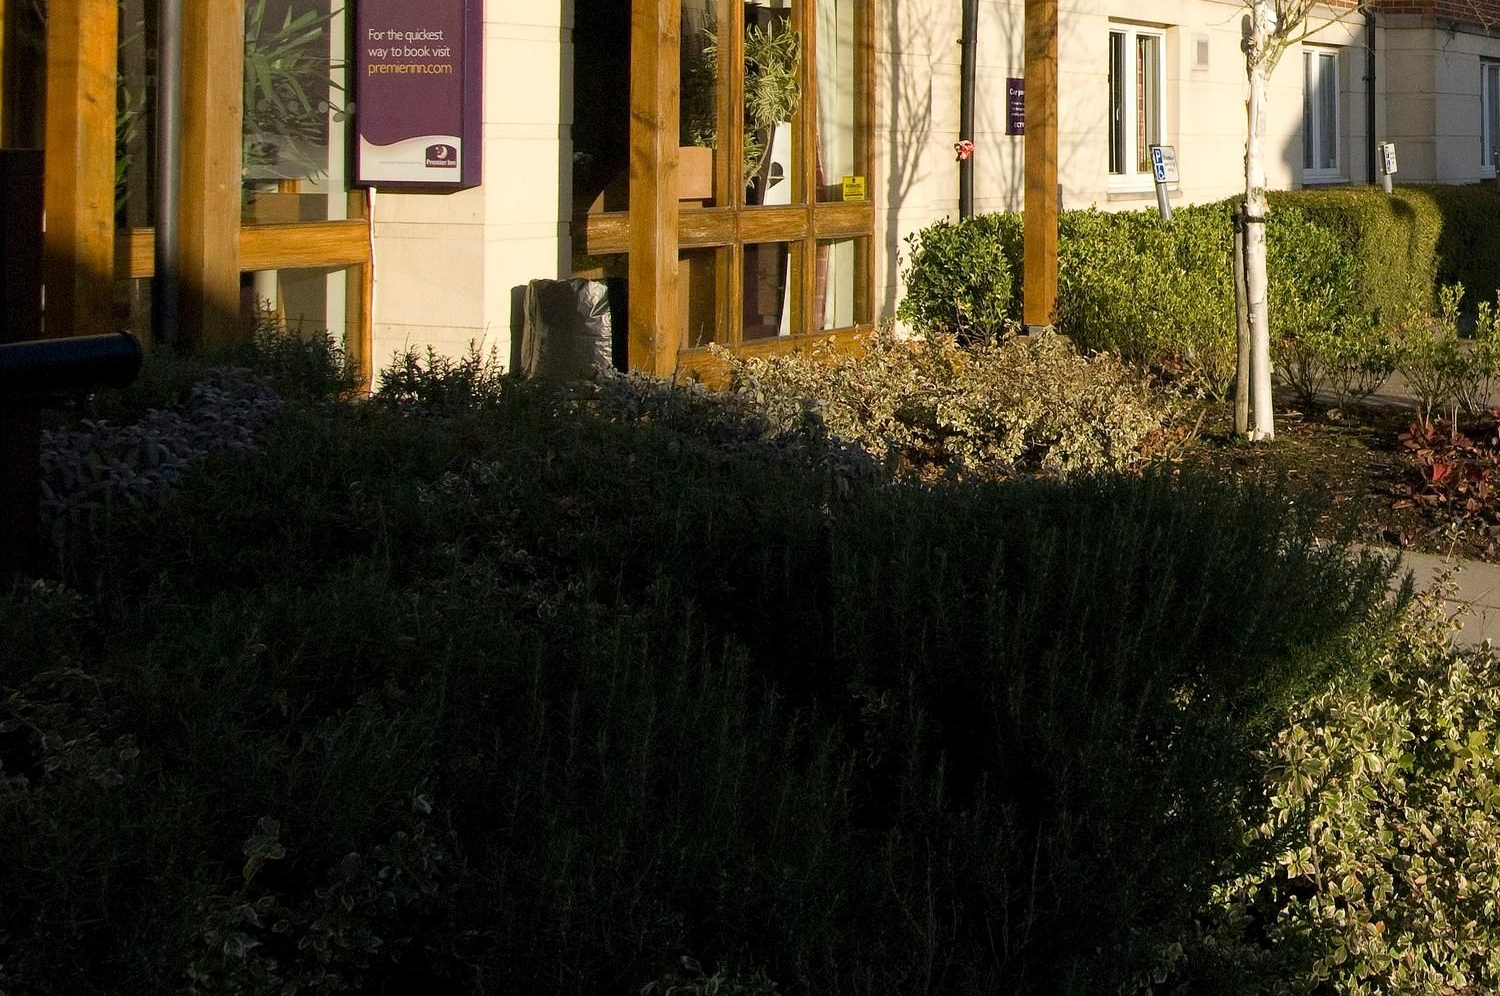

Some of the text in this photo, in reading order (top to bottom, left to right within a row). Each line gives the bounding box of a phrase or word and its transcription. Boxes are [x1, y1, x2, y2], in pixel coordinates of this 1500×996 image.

[368, 28, 444, 44] For the quickest
[368, 45, 451, 60] way to book visit
[368, 61, 453, 77] premierinn.com
[426, 158, 447, 166] Premier
